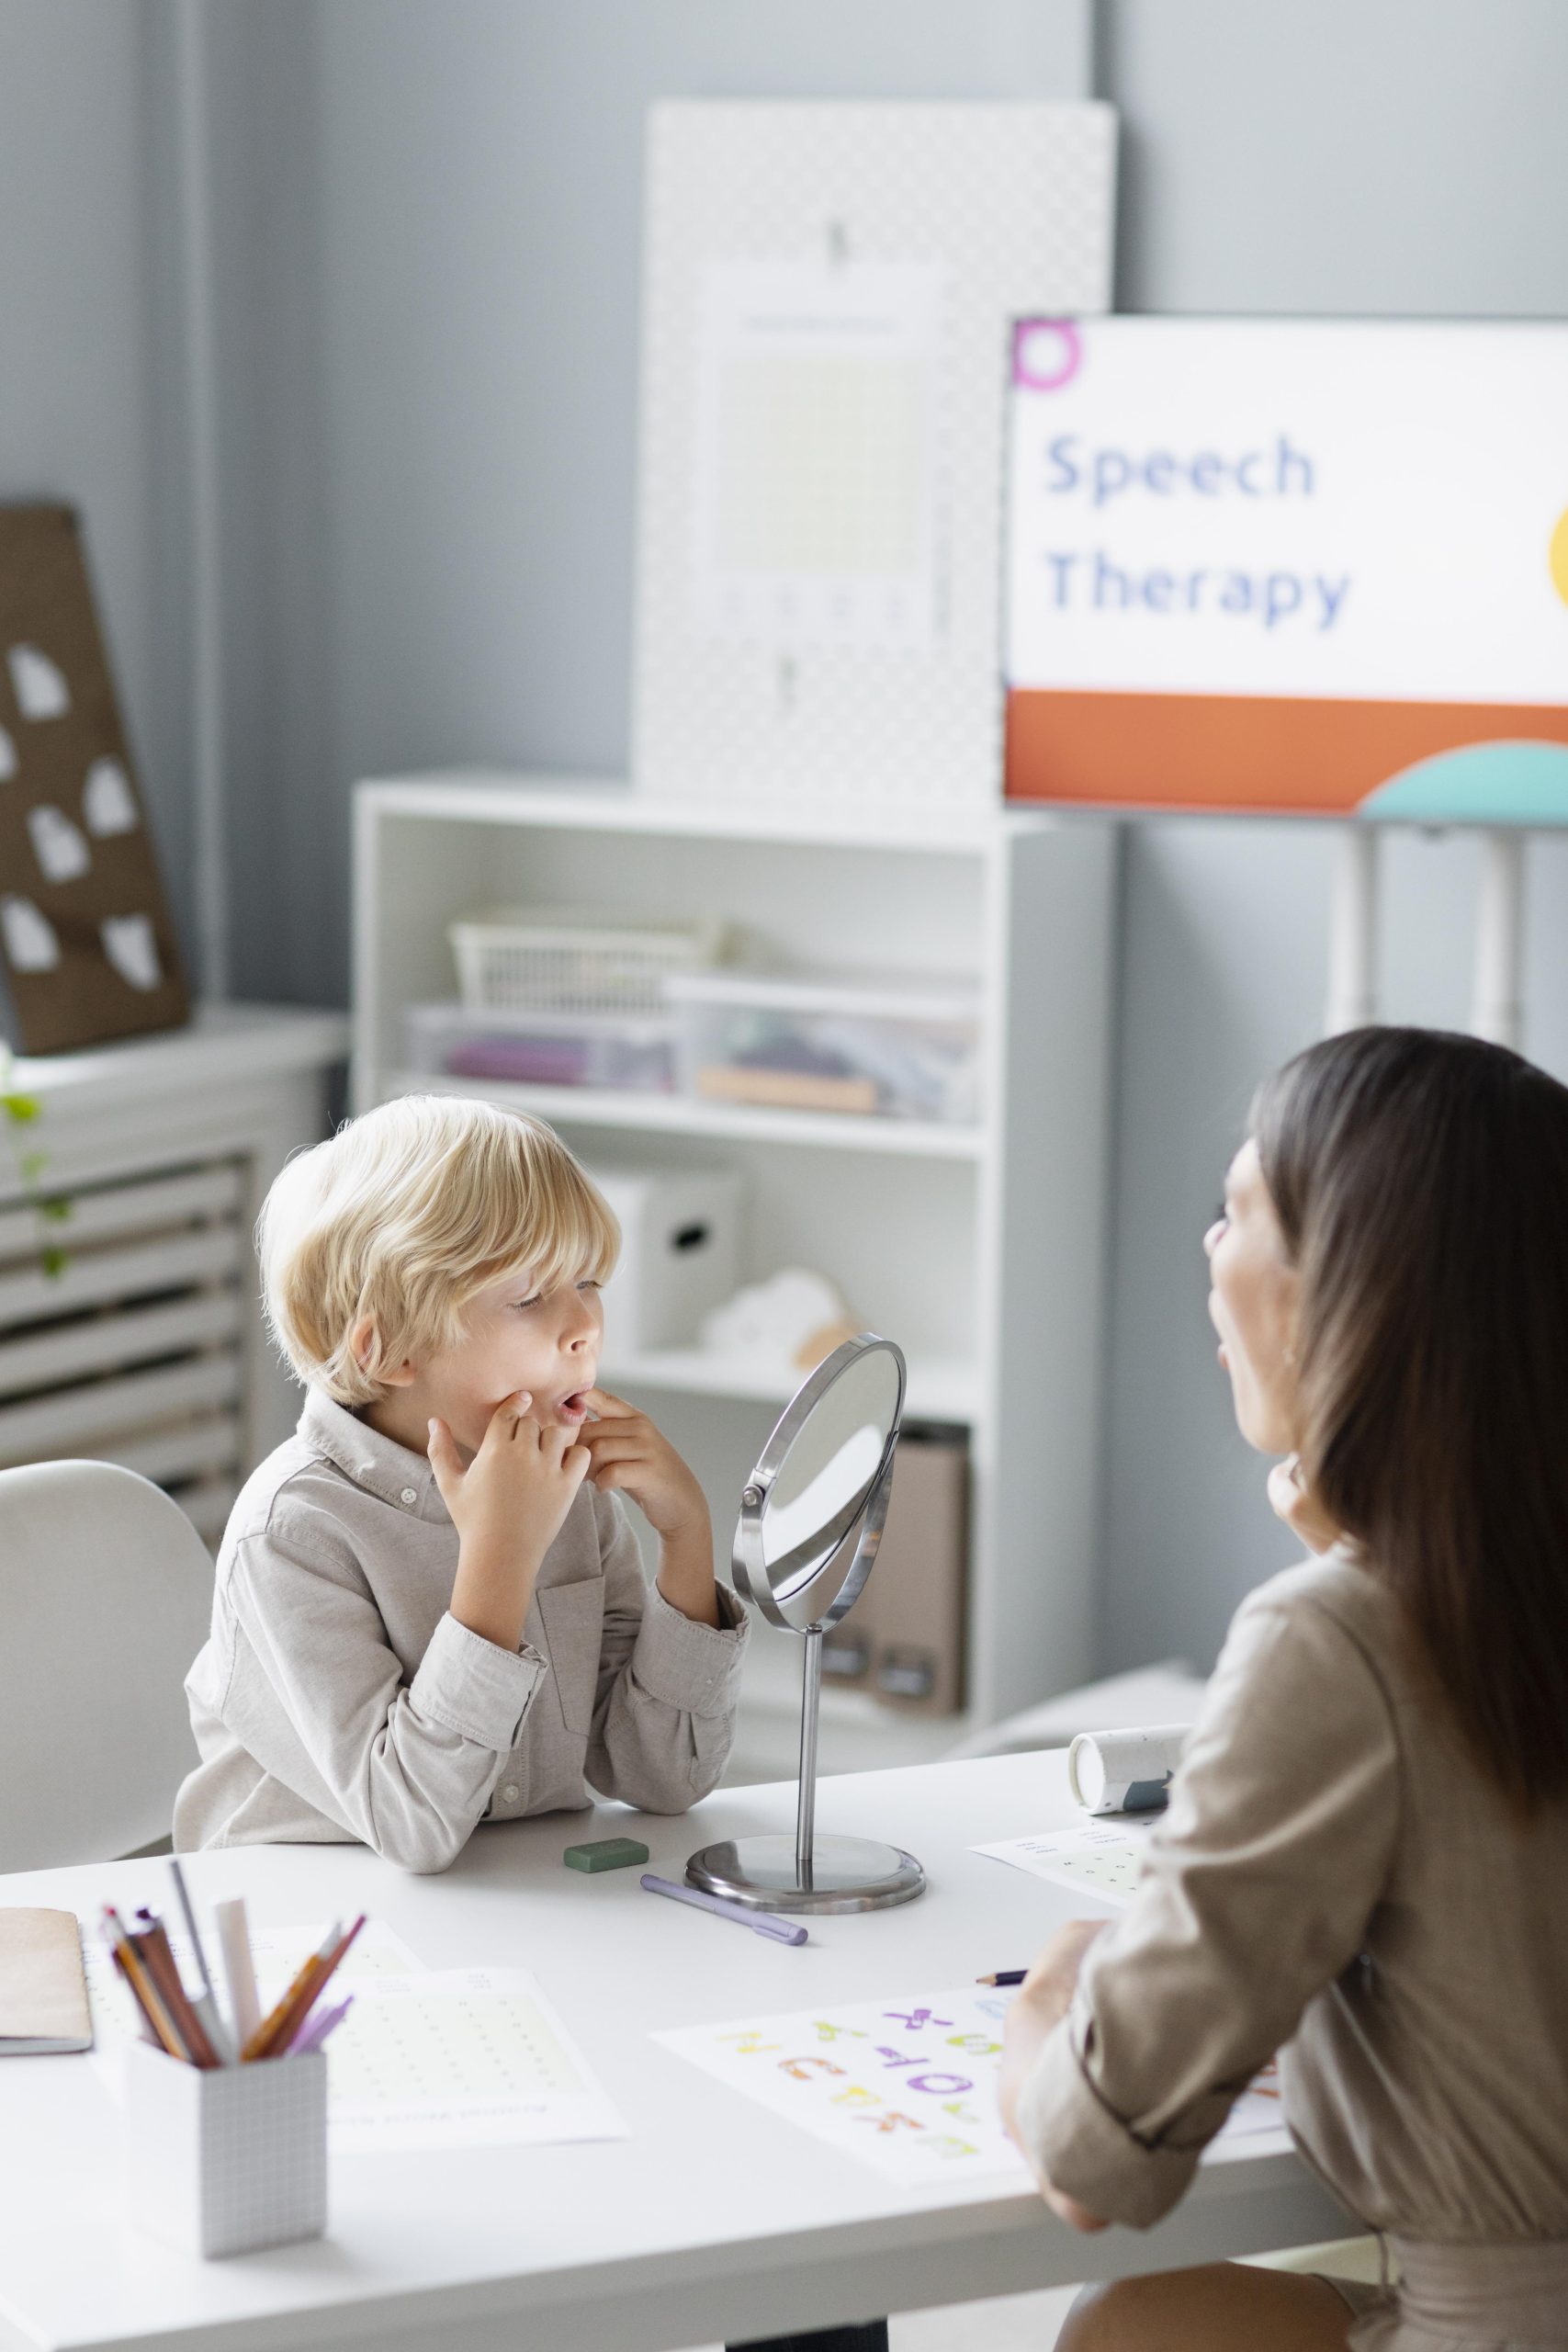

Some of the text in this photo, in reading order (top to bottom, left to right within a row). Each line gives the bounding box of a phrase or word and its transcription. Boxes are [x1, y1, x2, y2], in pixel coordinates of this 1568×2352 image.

[1045, 433, 1315, 507] Speech
[1047, 549, 1351, 632] Therapy
[883, 2007, 954, 2030] X
[874, 2045, 931, 2068] T
[906, 2073, 975, 2095] O
